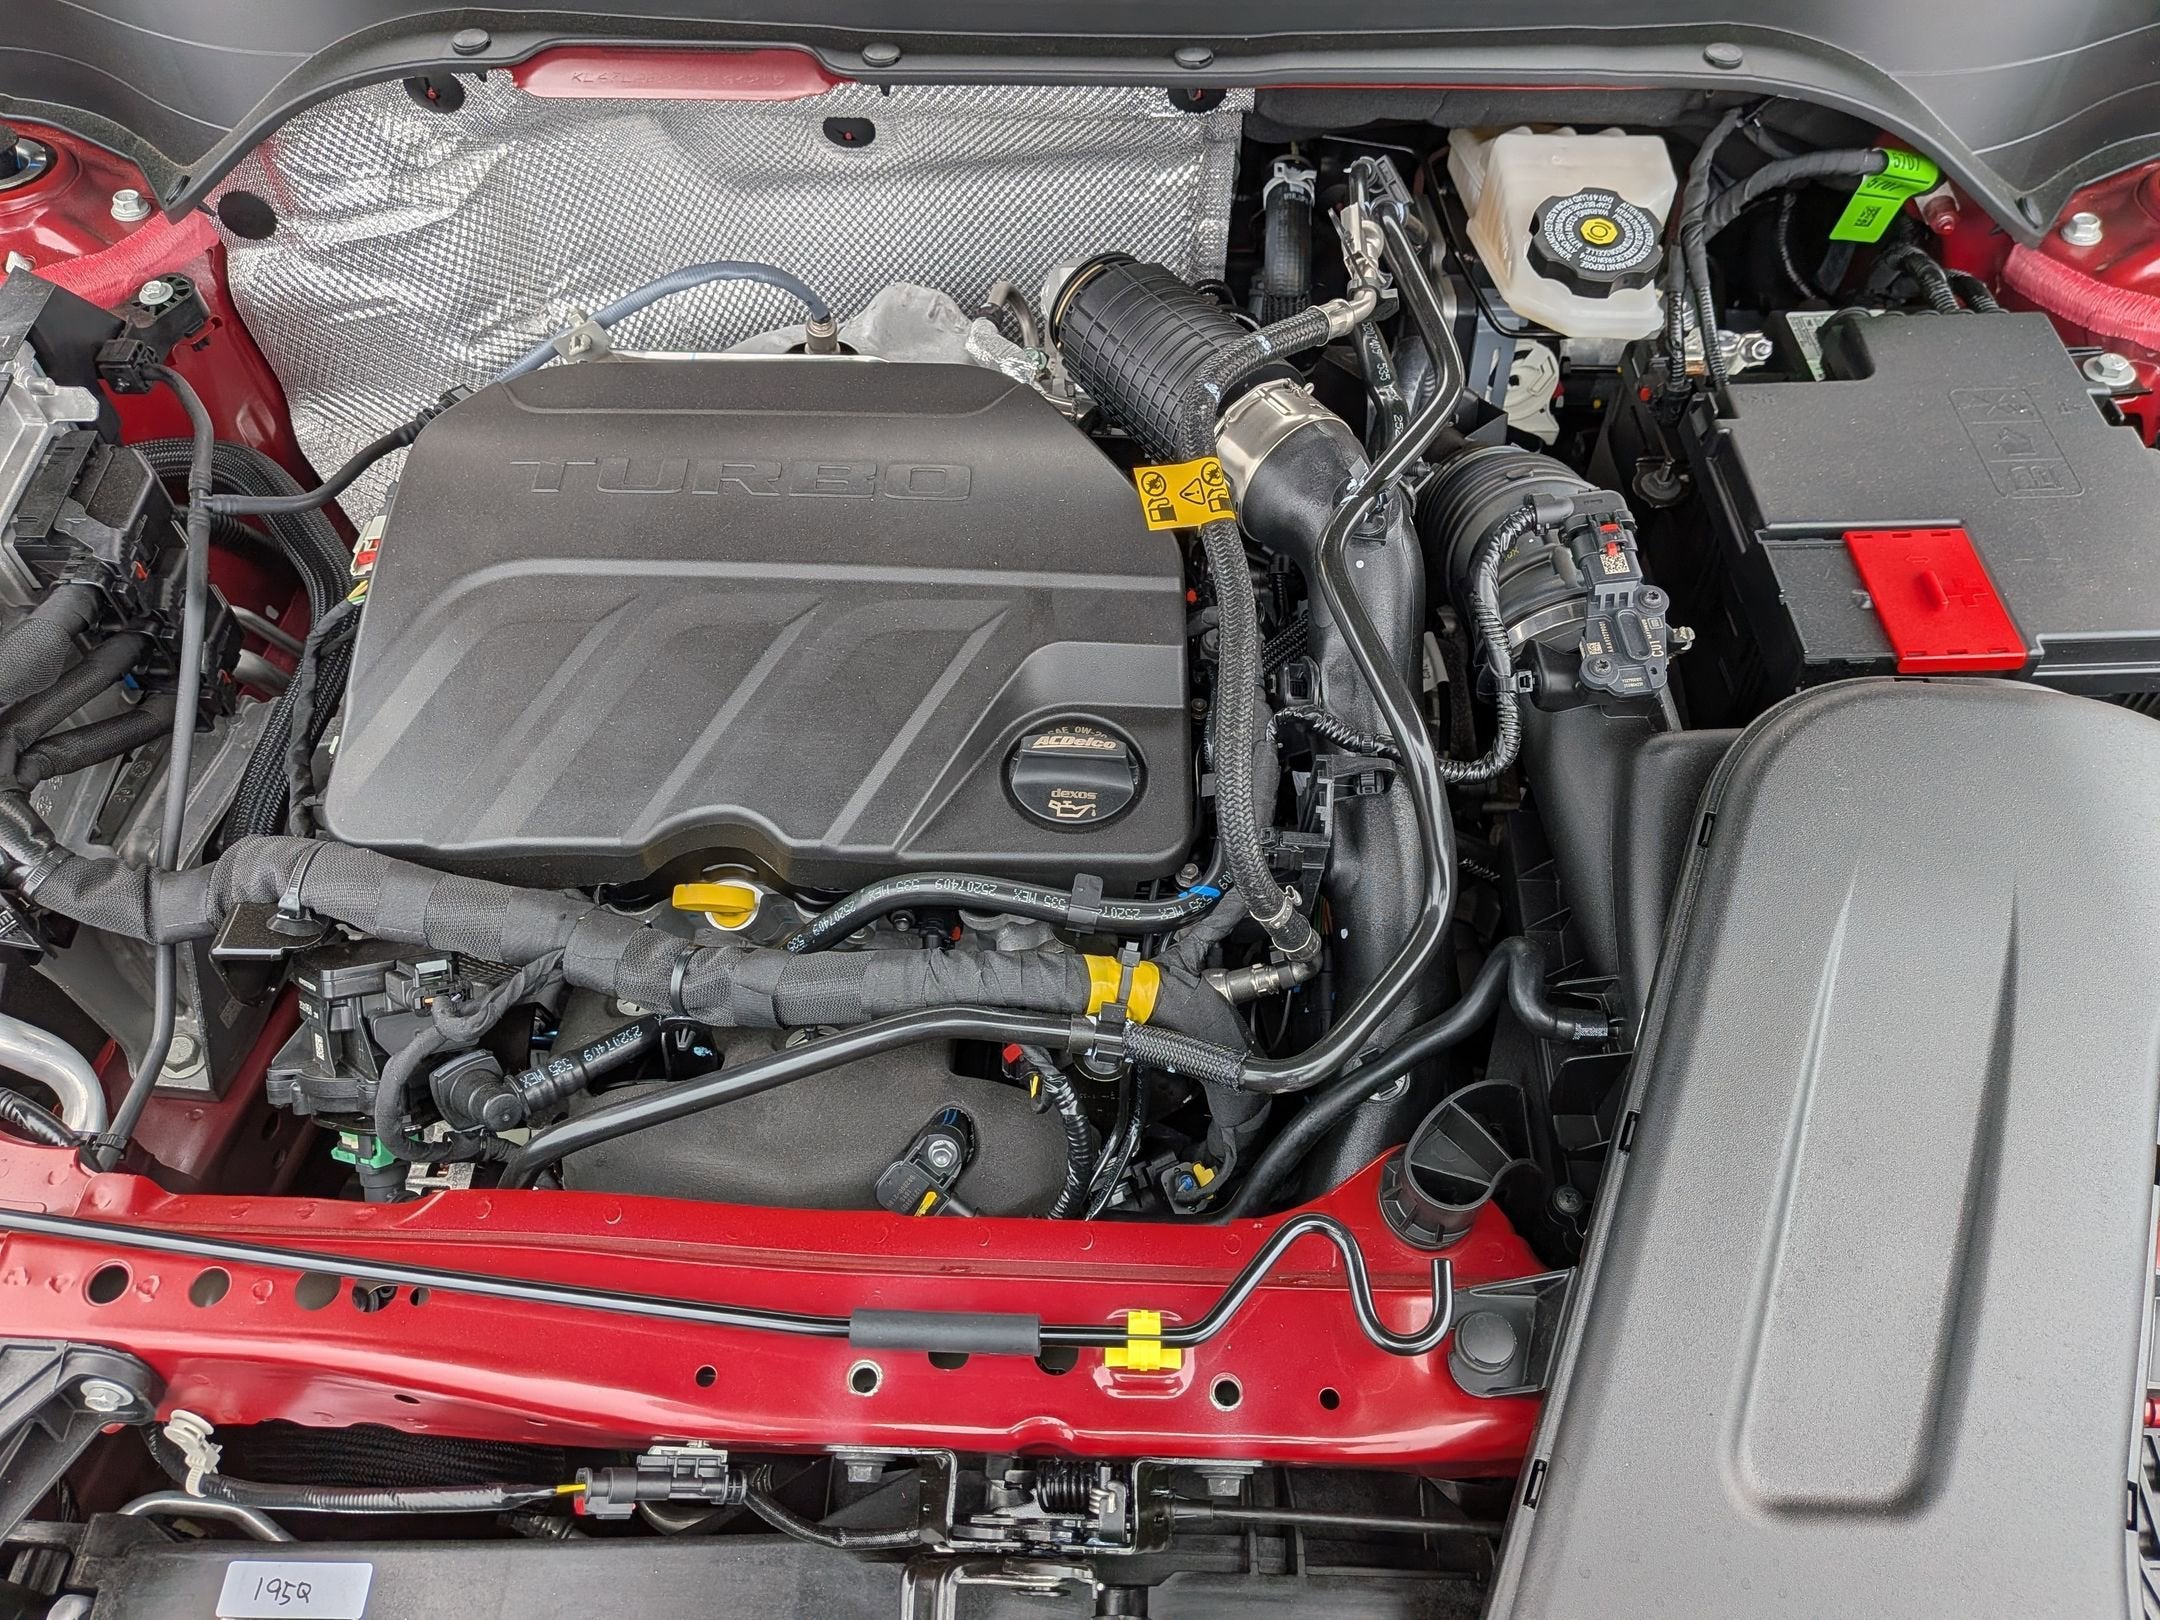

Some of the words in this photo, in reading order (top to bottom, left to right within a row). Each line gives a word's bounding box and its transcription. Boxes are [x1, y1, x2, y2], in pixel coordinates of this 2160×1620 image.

[1892, 152, 1921, 172] 5707
[1362, 321, 1382, 354] 5207409
[1377, 363, 1391, 381] 535
[510, 457, 973, 501] TURBO
[1033, 735, 1117, 749] ACDelco
[1051, 788, 1098, 800] dexos
[868, 882, 889, 902] MEX
[895, 879, 920, 892] 535
[934, 878, 998, 898] 25207409
[1013, 888, 1037, 905] MEX
[1043, 895, 1066, 911] 535
[811, 900, 858, 935] 25207409
[1158, 904, 1184, 920] MEX
[786, 933, 805, 954] 535
[547, 1056, 575, 1078] 535
[518, 1067, 545, 1091] MEX
